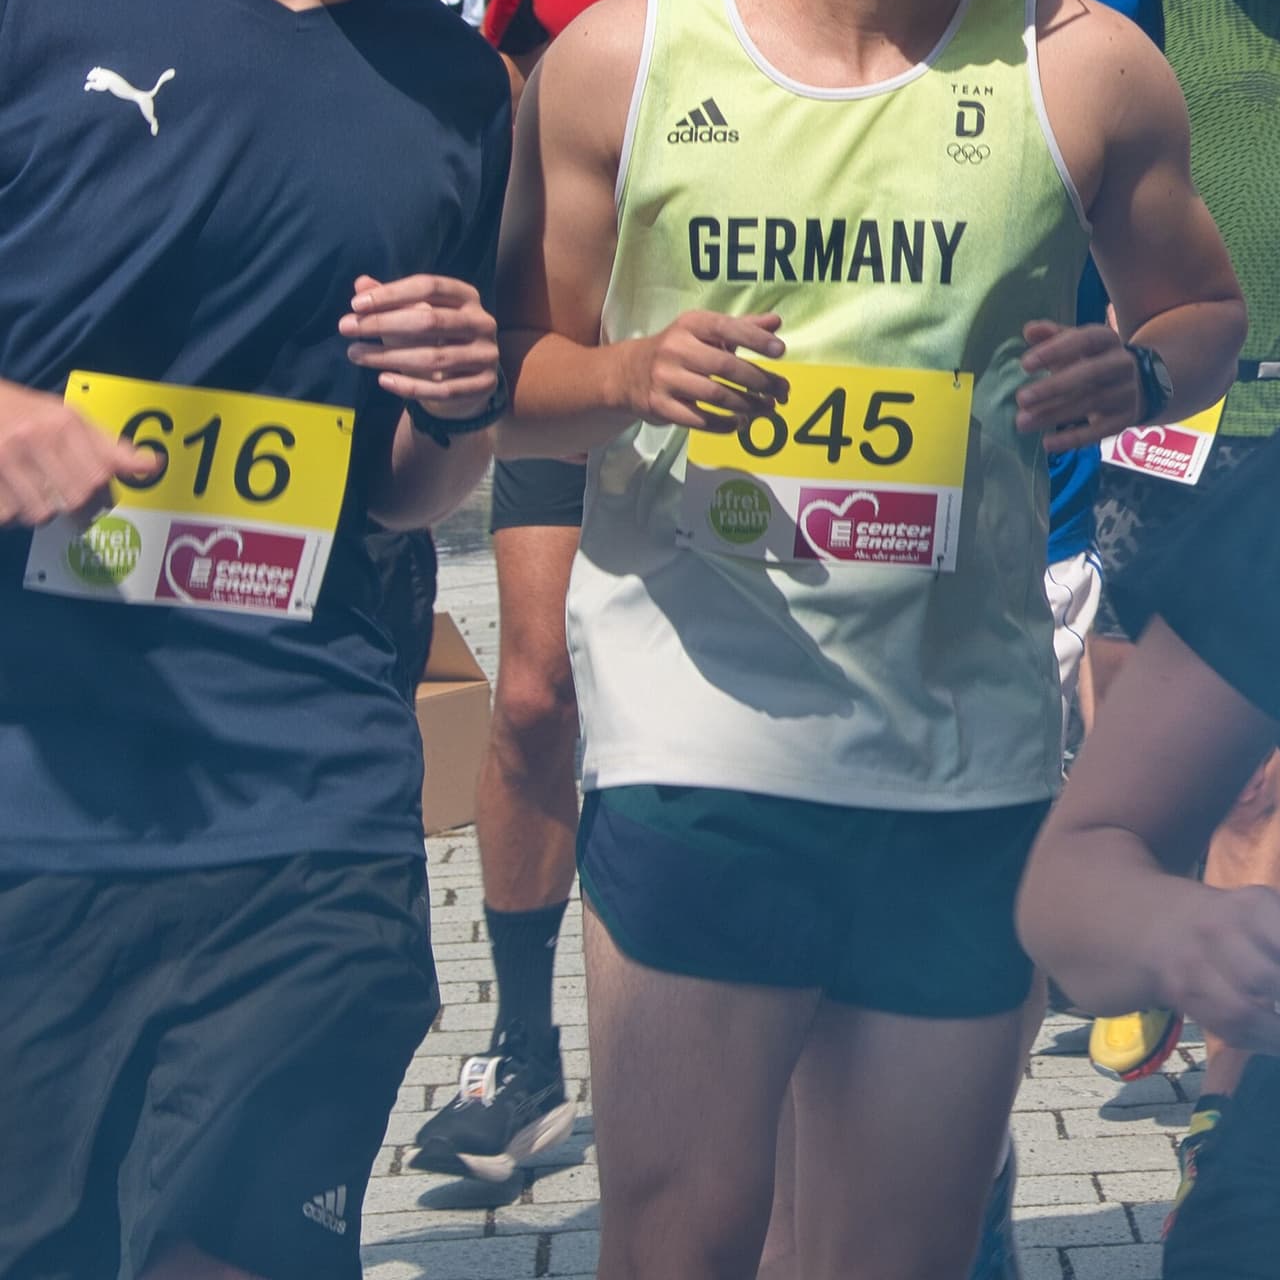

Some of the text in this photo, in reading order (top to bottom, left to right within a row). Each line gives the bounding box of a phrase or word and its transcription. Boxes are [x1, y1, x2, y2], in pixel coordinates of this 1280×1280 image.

[951, 83, 994, 96] TEAM
[667, 126, 740, 145] adidas
[687, 215, 968, 286] GERMANY
[736, 387, 915, 466] 645
[116, 409, 296, 504] 616
[720, 510, 769, 527] raum
[856, 521, 931, 537] center
[855, 533, 929, 552] Enders
